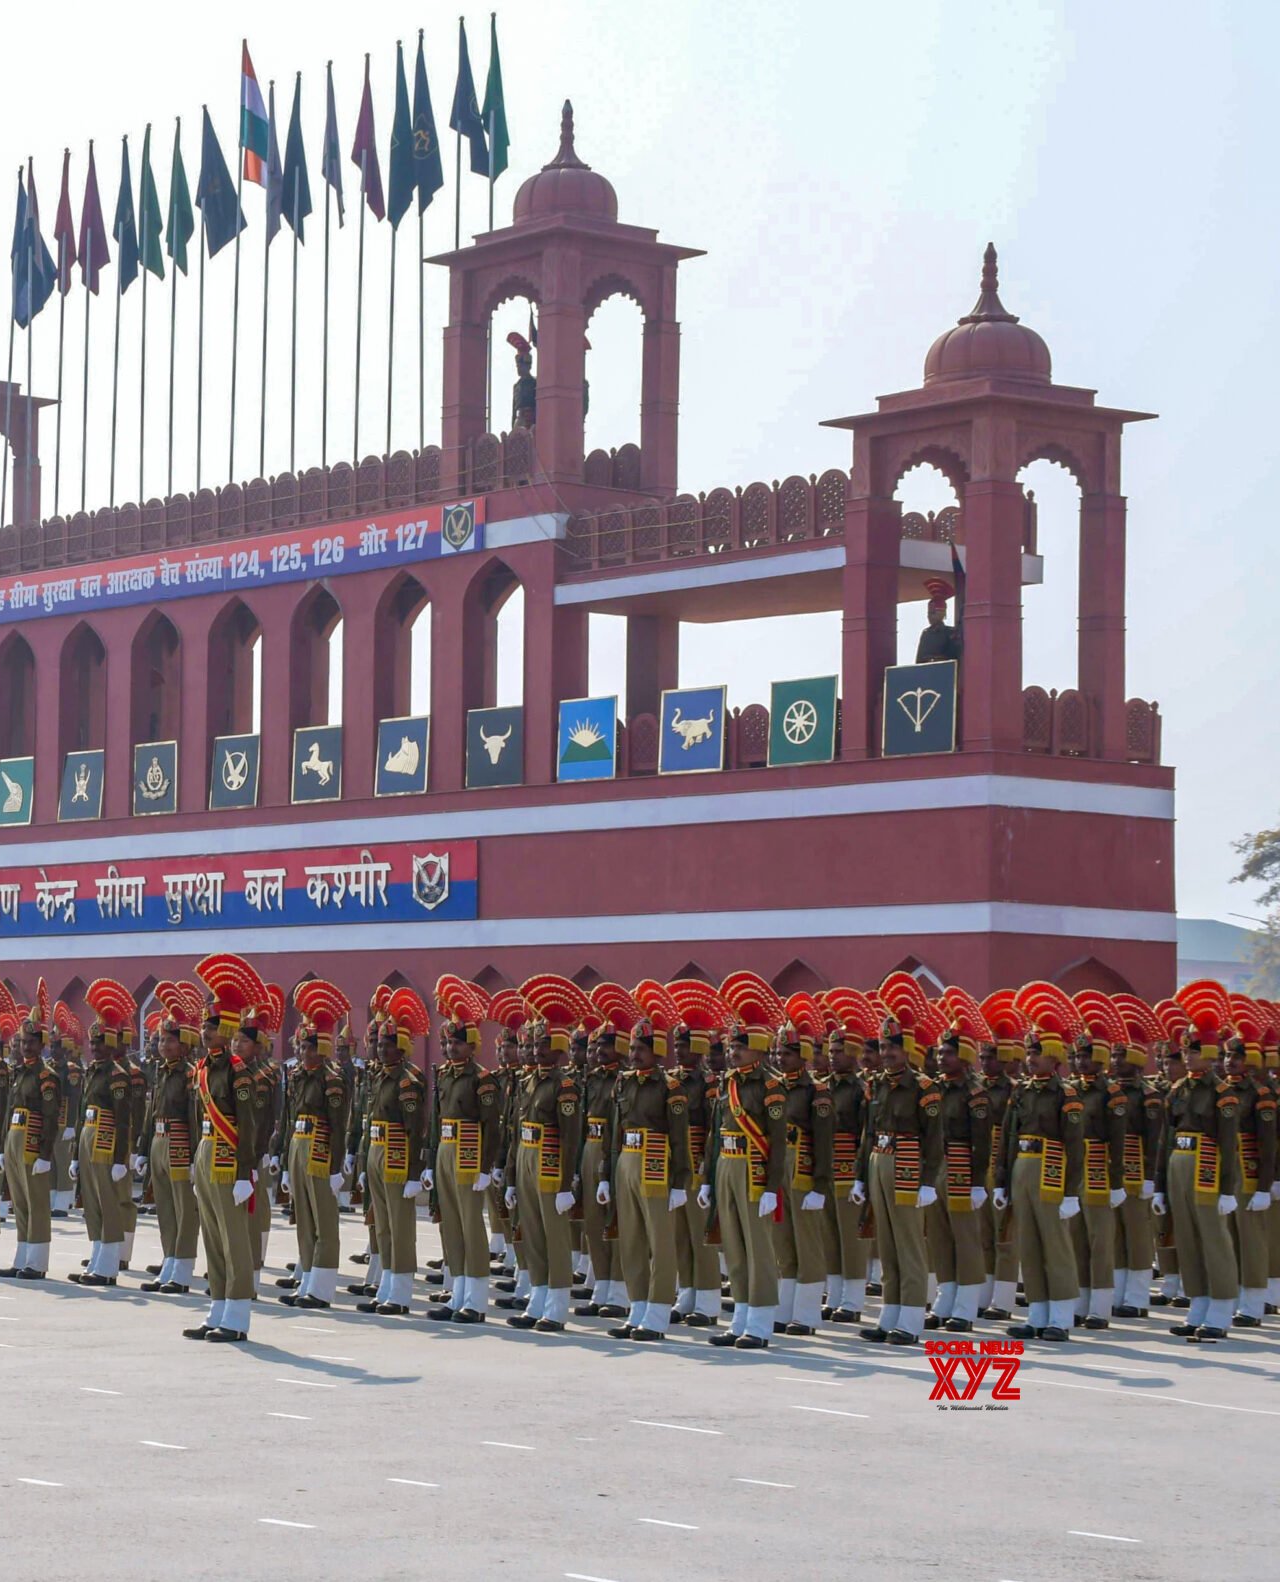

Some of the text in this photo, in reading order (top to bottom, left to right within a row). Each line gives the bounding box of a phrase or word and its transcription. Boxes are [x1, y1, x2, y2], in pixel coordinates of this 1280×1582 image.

[9, 581, 39, 609] सीमा
[41, 579, 77, 612] सुरक्षा
[106, 566, 156, 595] आरक्षक
[185, 553, 223, 583] संख्या
[229, 549, 265, 579] 124,
[270, 543, 307, 572] 125,
[312, 535, 345, 566] 126
[359, 523, 388, 556] और
[395, 520, 428, 552] 127
[34, 867, 78, 923] केन्द्र
[95, 864, 146, 918] सीमा
[162, 872, 225, 924] सुरक्षा
[243, 868, 286, 912] बल
[304, 849, 392, 910] कश्मीर
